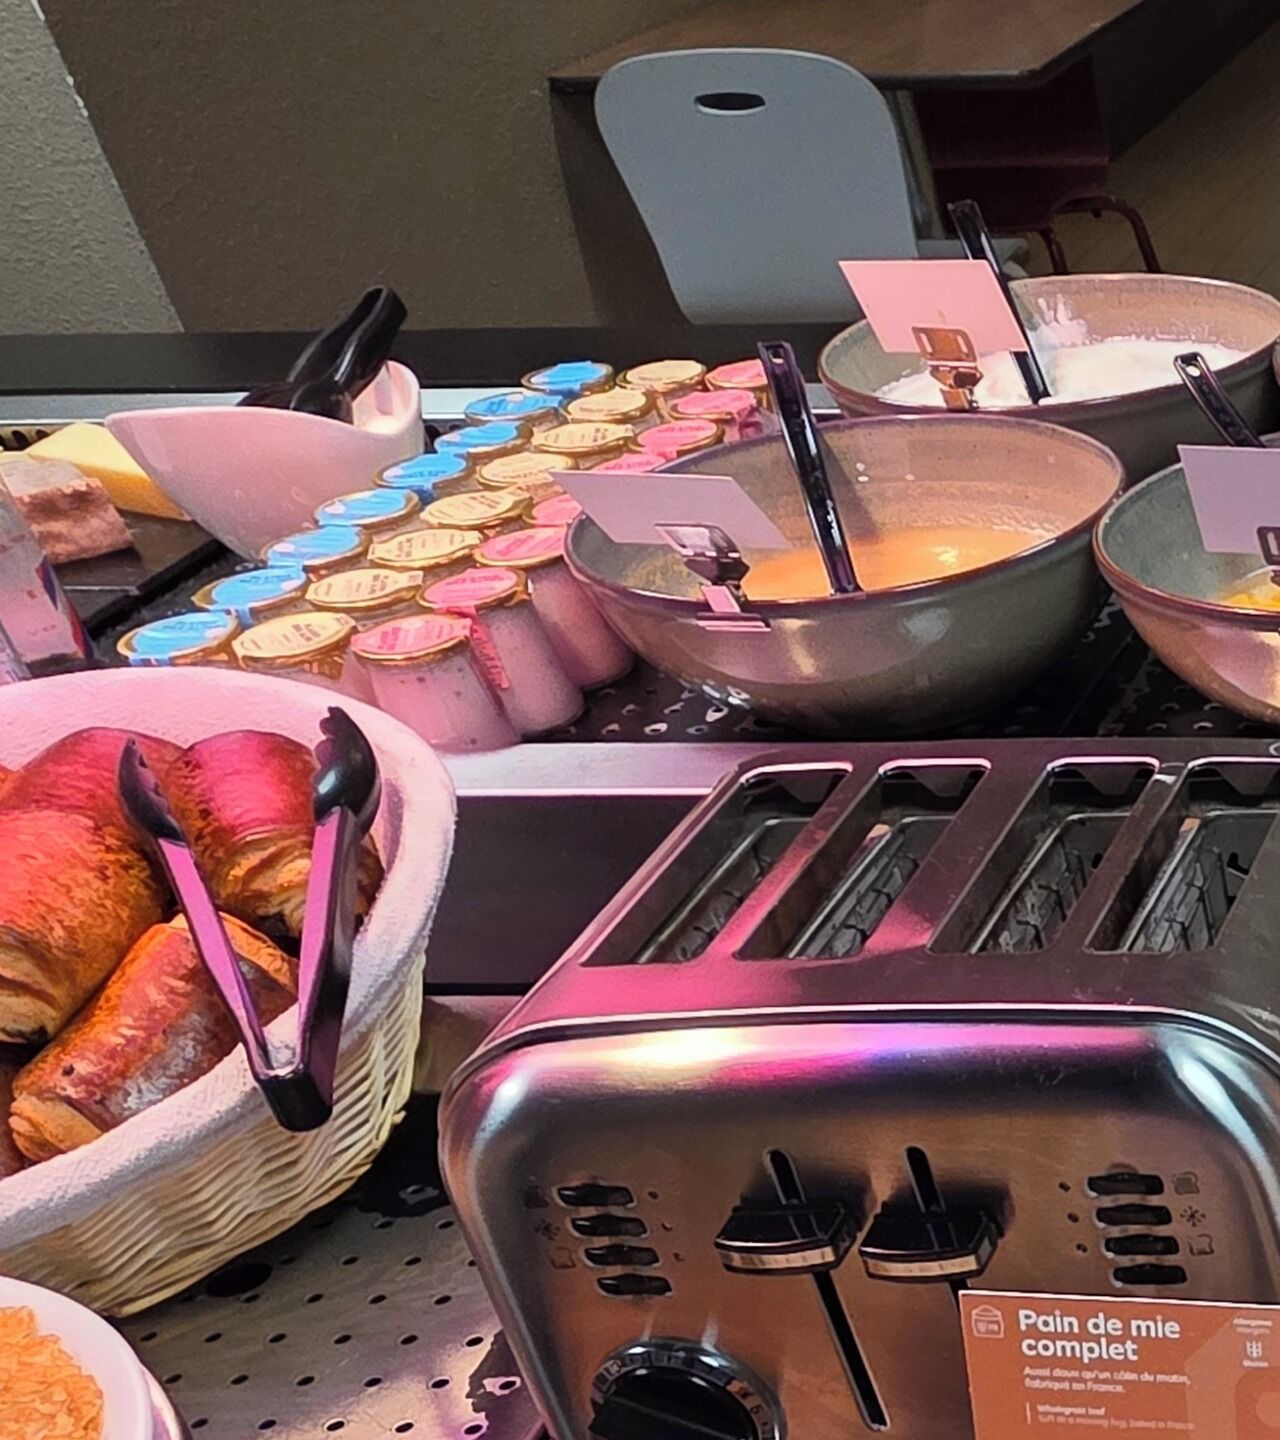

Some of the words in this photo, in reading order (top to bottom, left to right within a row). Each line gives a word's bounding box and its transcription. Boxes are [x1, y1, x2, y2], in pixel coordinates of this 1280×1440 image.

[1018, 1309, 1079, 1333] Pain
[1087, 1312, 1123, 1335] de
[1130, 1315, 1181, 1338] mie
[1021, 1337, 1138, 1364] complet
